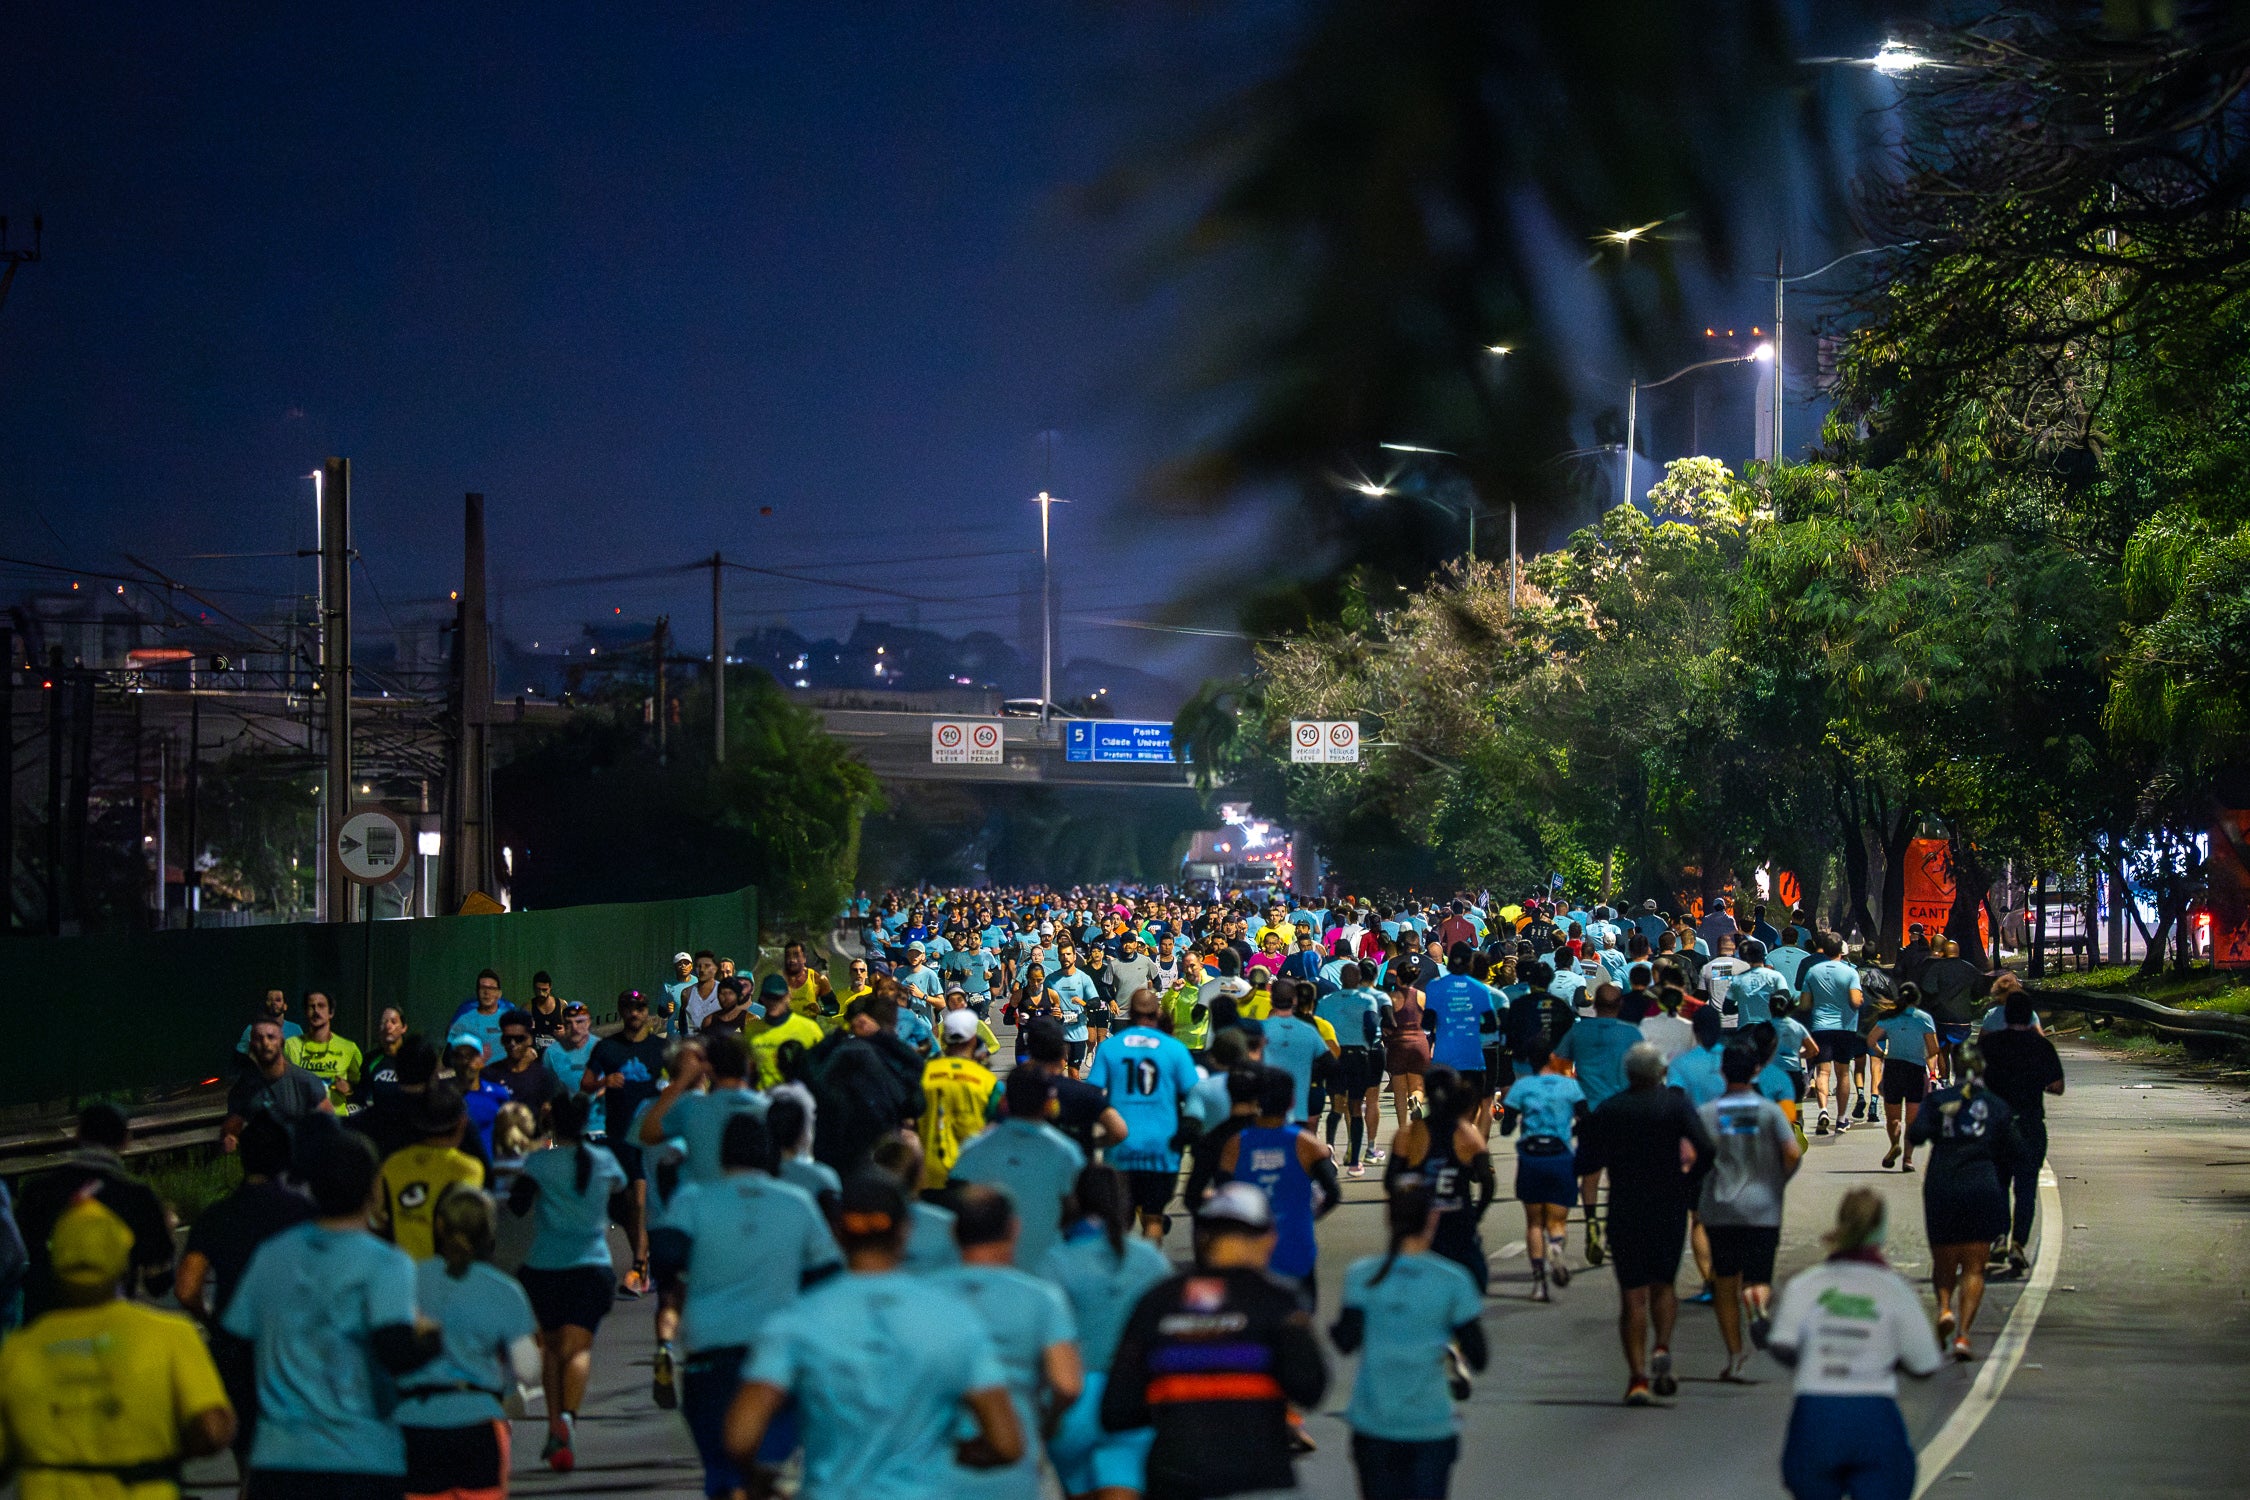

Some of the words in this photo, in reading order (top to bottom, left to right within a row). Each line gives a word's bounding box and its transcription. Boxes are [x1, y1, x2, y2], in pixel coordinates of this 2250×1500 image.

[943, 731, 957, 742] 90
[979, 731, 993, 741] 60
[1075, 729, 1084, 742] 5
[1133, 728, 1160, 736] Ponte
[1301, 729, 1316, 740] 90
[1333, 729, 1349, 740] 60
[1909, 907, 1947, 919] CANT
[1121, 1057, 1159, 1095] 10
